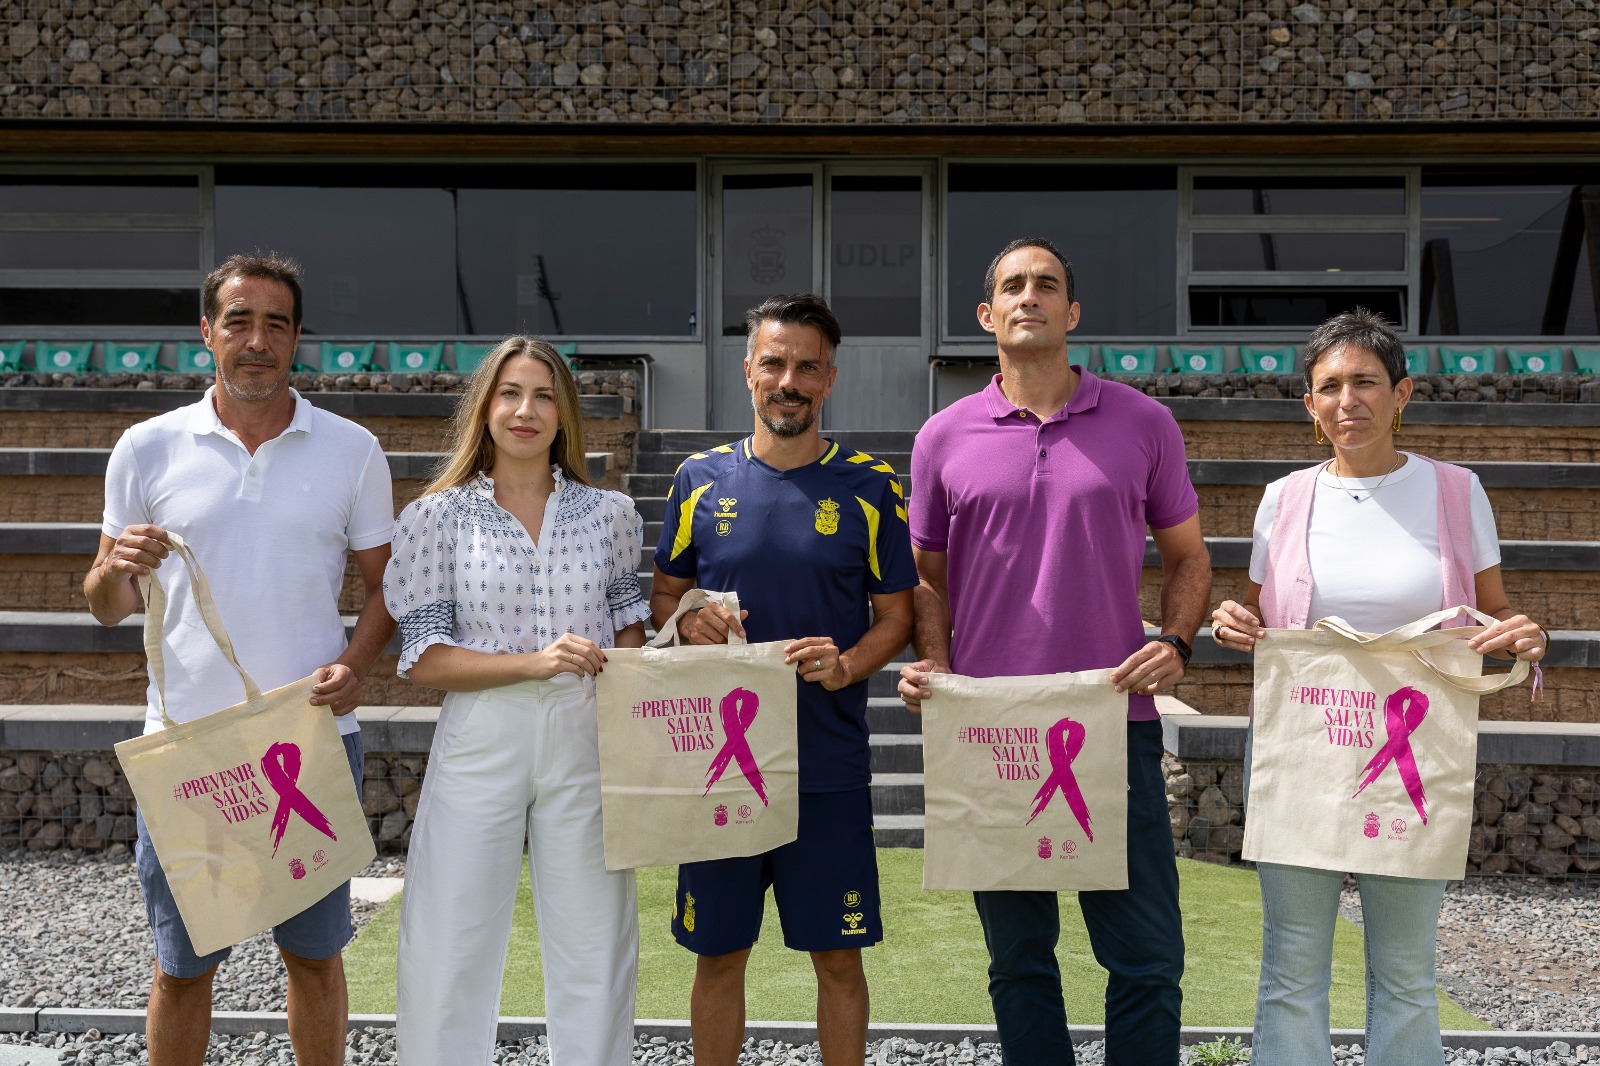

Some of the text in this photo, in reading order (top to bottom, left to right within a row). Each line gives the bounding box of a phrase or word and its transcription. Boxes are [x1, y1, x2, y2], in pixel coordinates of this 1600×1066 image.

[835, 243, 915, 268] UDLP
[713, 510, 738, 518] hummel
[631, 697, 713, 719] #PREVENIR
[1289, 686, 1377, 711] #PREVENIR
[667, 715, 714, 735] SALVA
[1324, 707, 1375, 730] SALVA
[672, 734, 714, 753] VIDAS
[957, 726, 1039, 745] #PREVENIR
[1327, 727, 1374, 749] VIDAS
[992, 745, 1040, 763] SALVA
[173, 762, 256, 801] #PREVENIR
[996, 763, 1040, 781] VIDAS
[212, 780, 263, 809] SALVA
[221, 797, 269, 825] VIDAS
[841, 926, 867, 936] hummel
